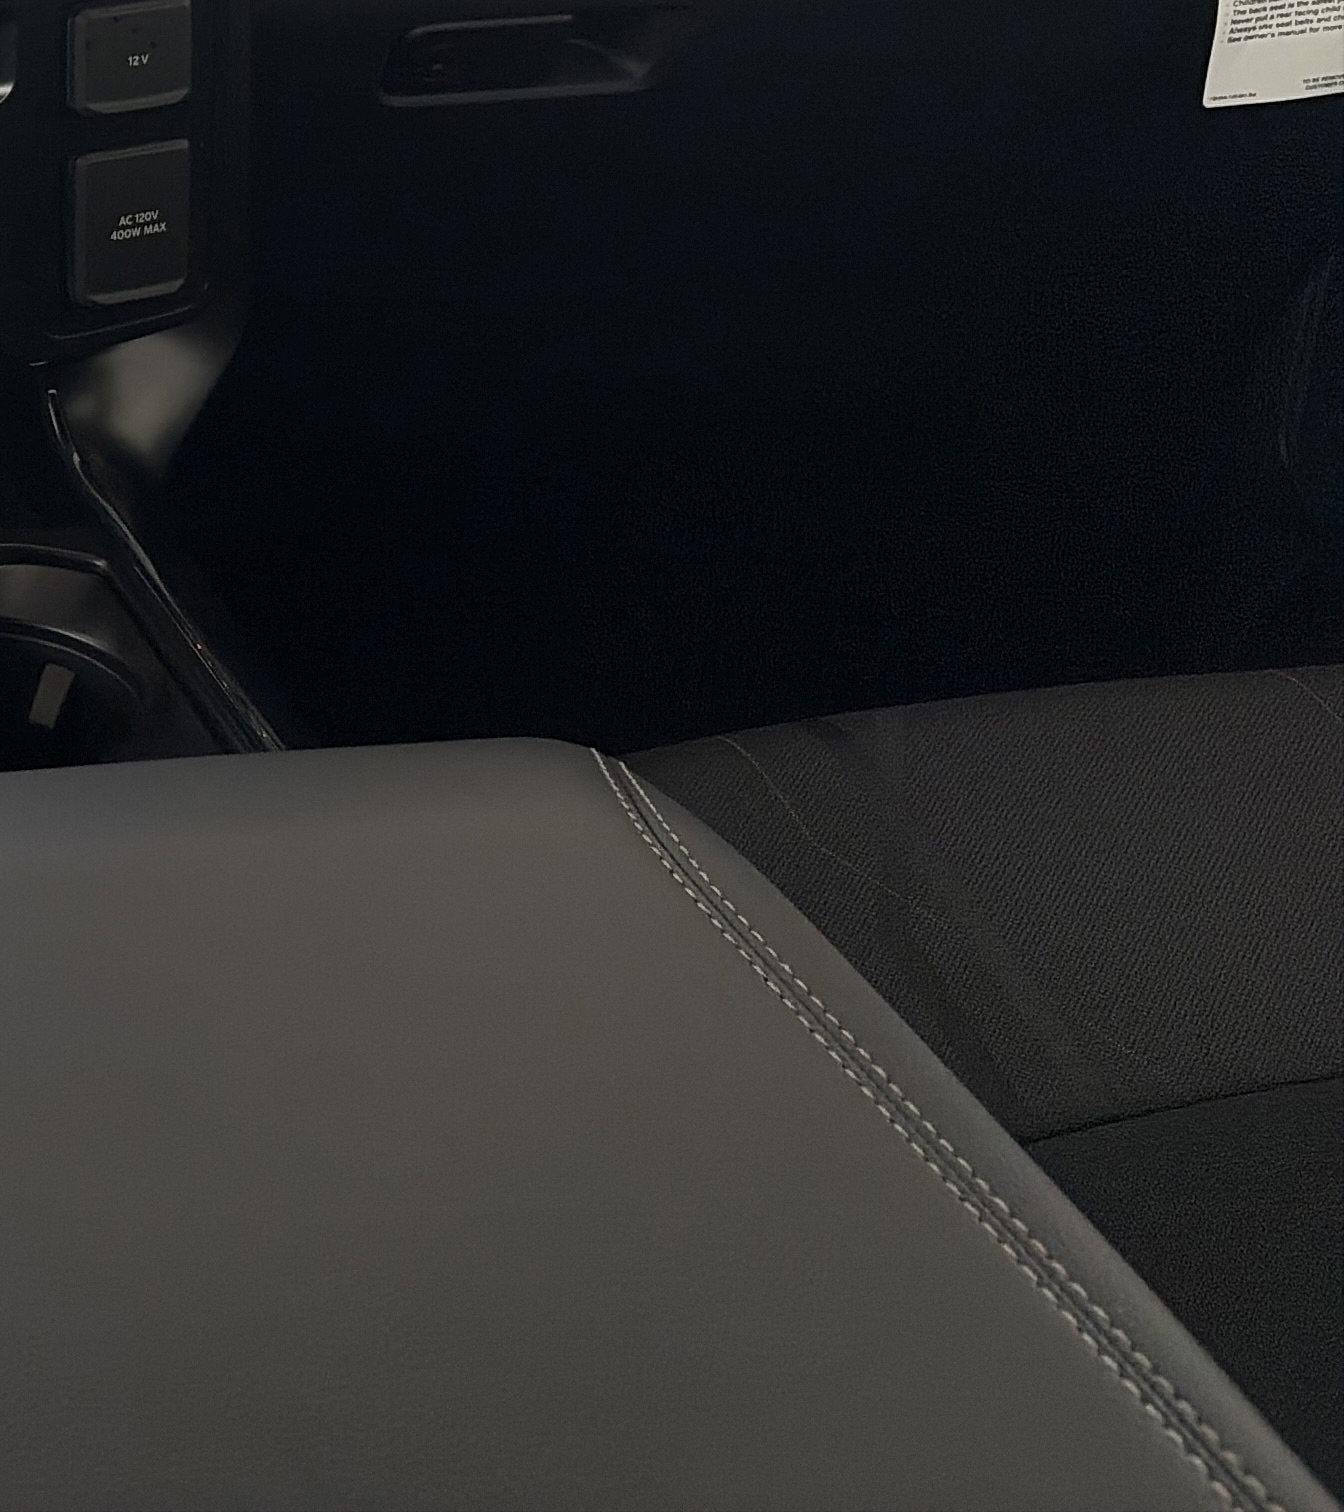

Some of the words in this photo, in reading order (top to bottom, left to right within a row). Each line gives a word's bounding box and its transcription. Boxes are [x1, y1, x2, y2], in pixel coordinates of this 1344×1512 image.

[127, 55, 140, 67] 12
[140, 54, 150, 65] V
[118, 213, 135, 227] AC
[135, 210, 160, 224] 120V
[110, 225, 142, 241] 400W
[143, 222, 167, 236] MAX
